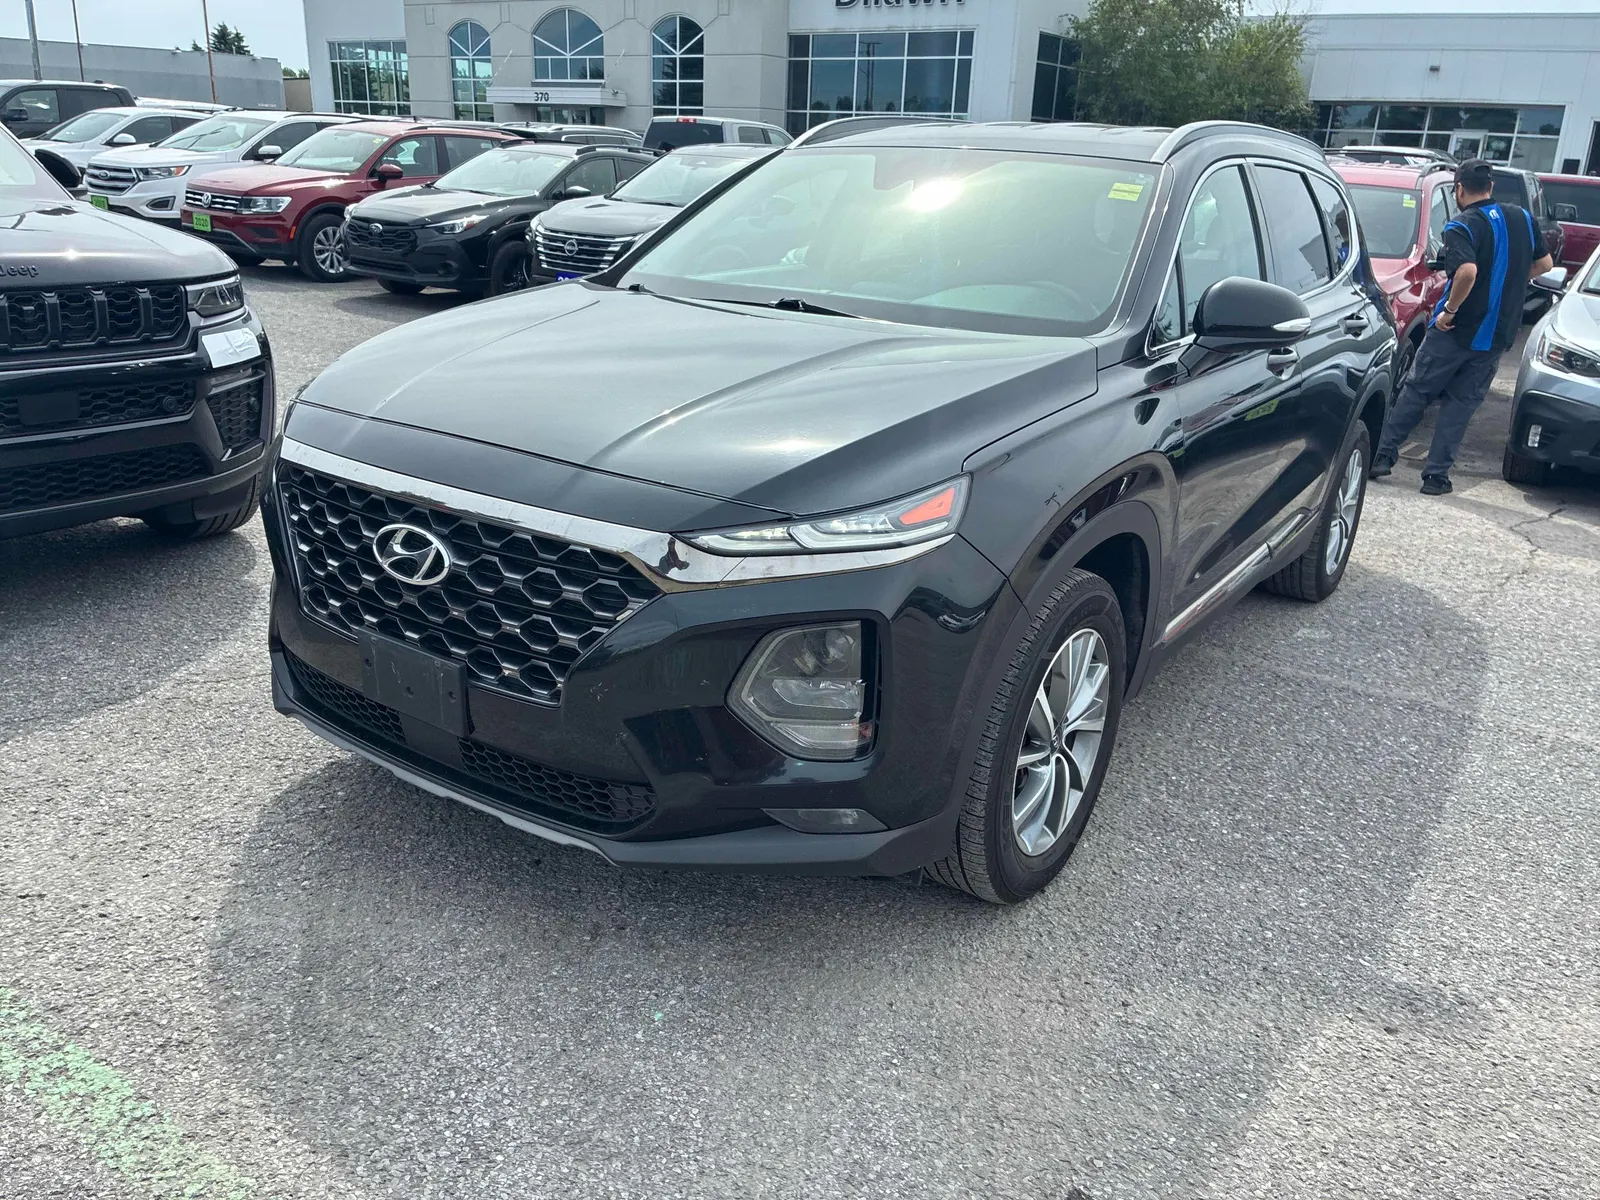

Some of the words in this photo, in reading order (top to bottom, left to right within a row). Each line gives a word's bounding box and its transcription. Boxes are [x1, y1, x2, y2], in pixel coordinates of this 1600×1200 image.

[534, 92, 550, 102] 370
[194, 217, 209, 228] 2020
[0, 265, 39, 278] Jeep
